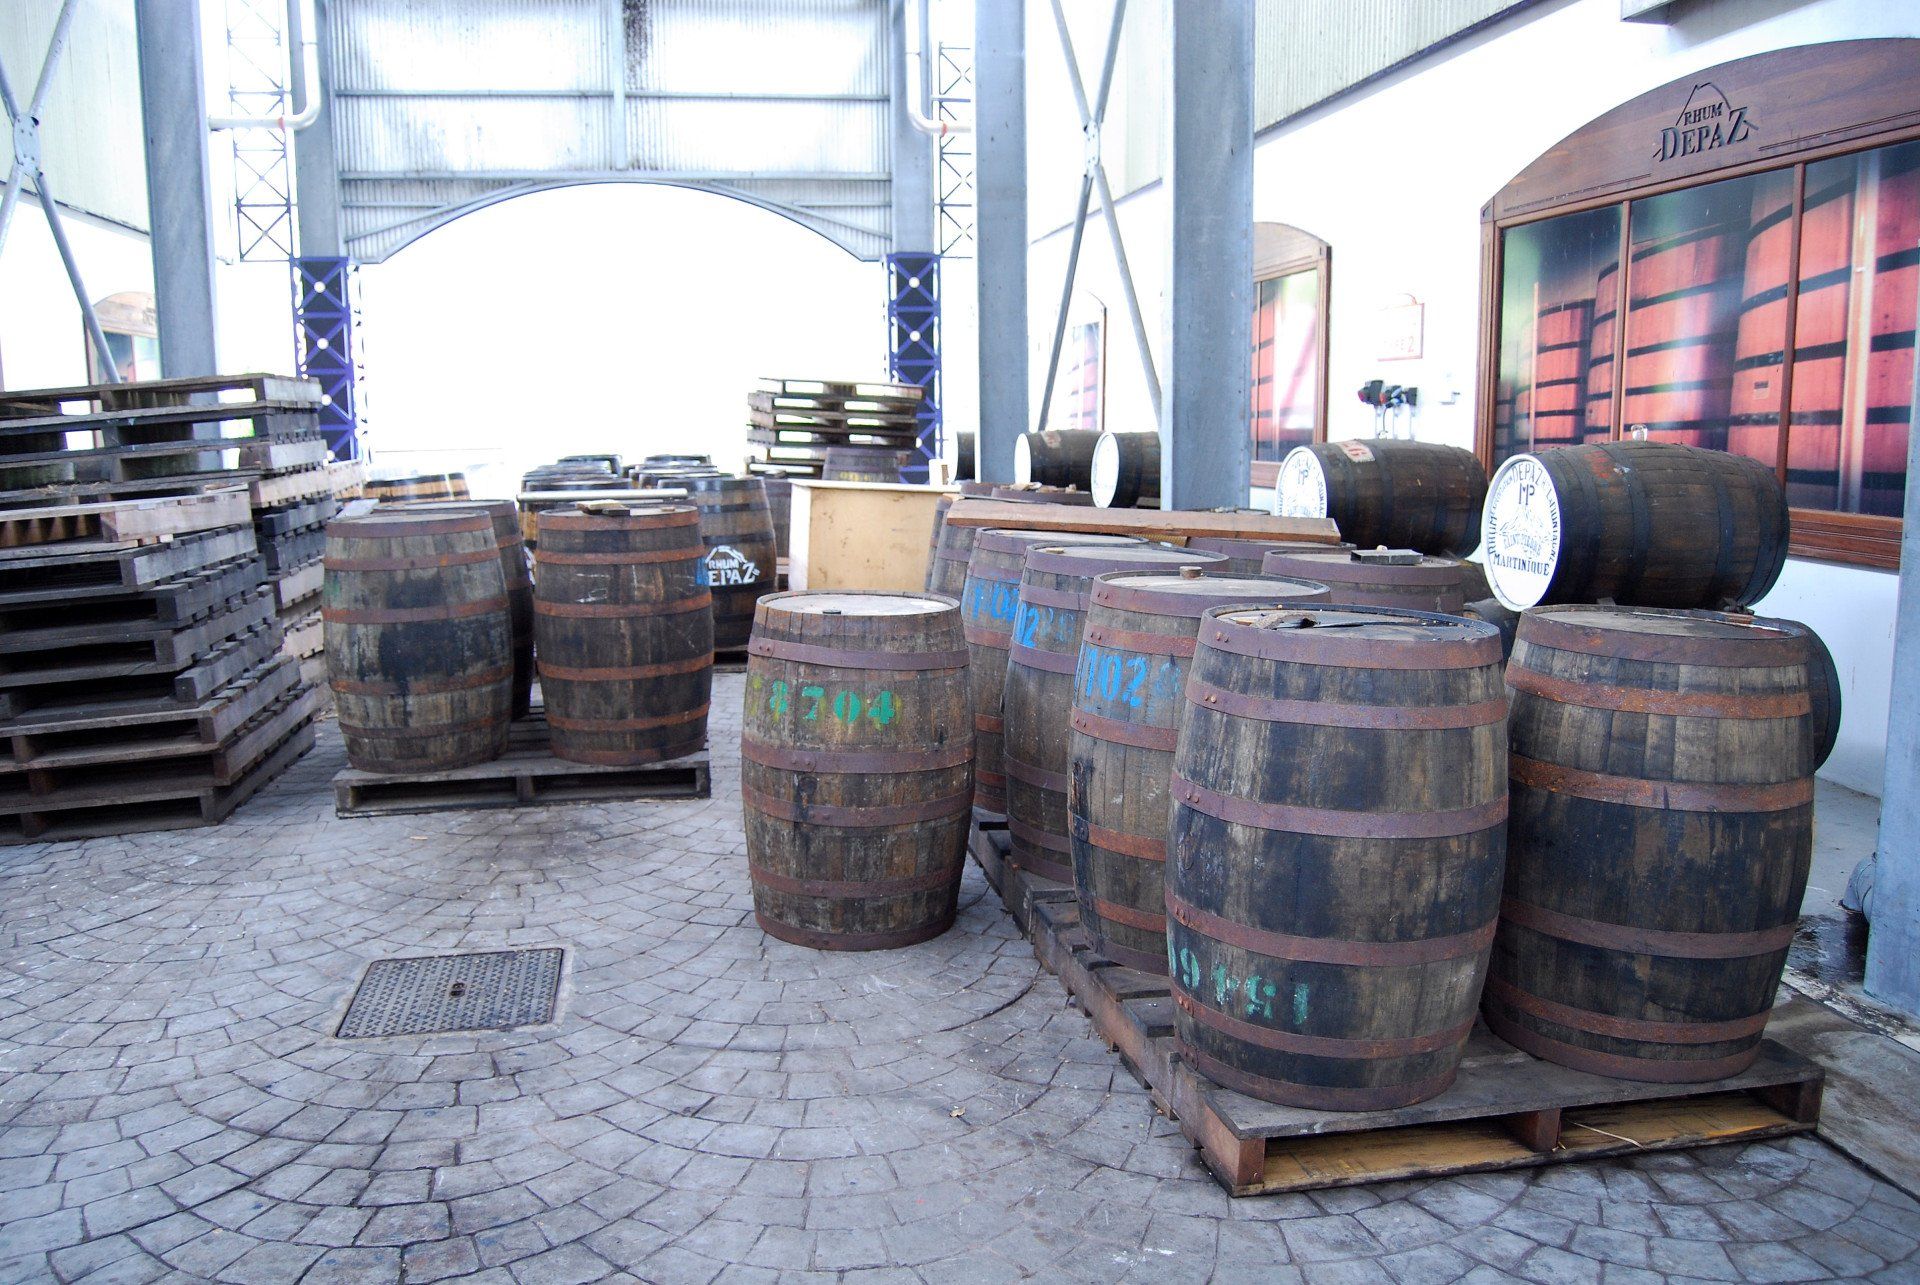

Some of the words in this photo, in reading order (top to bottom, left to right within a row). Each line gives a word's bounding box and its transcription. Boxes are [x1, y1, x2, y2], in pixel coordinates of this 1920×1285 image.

[1684, 102, 1724, 126] RHUM
[1660, 107, 1749, 162] DEPAZ
[1512, 463, 1543, 487] DEPAZ
[708, 558, 739, 570] RHUM
[708, 562, 756, 587] EPAZ
[769, 679, 896, 725] 8704
